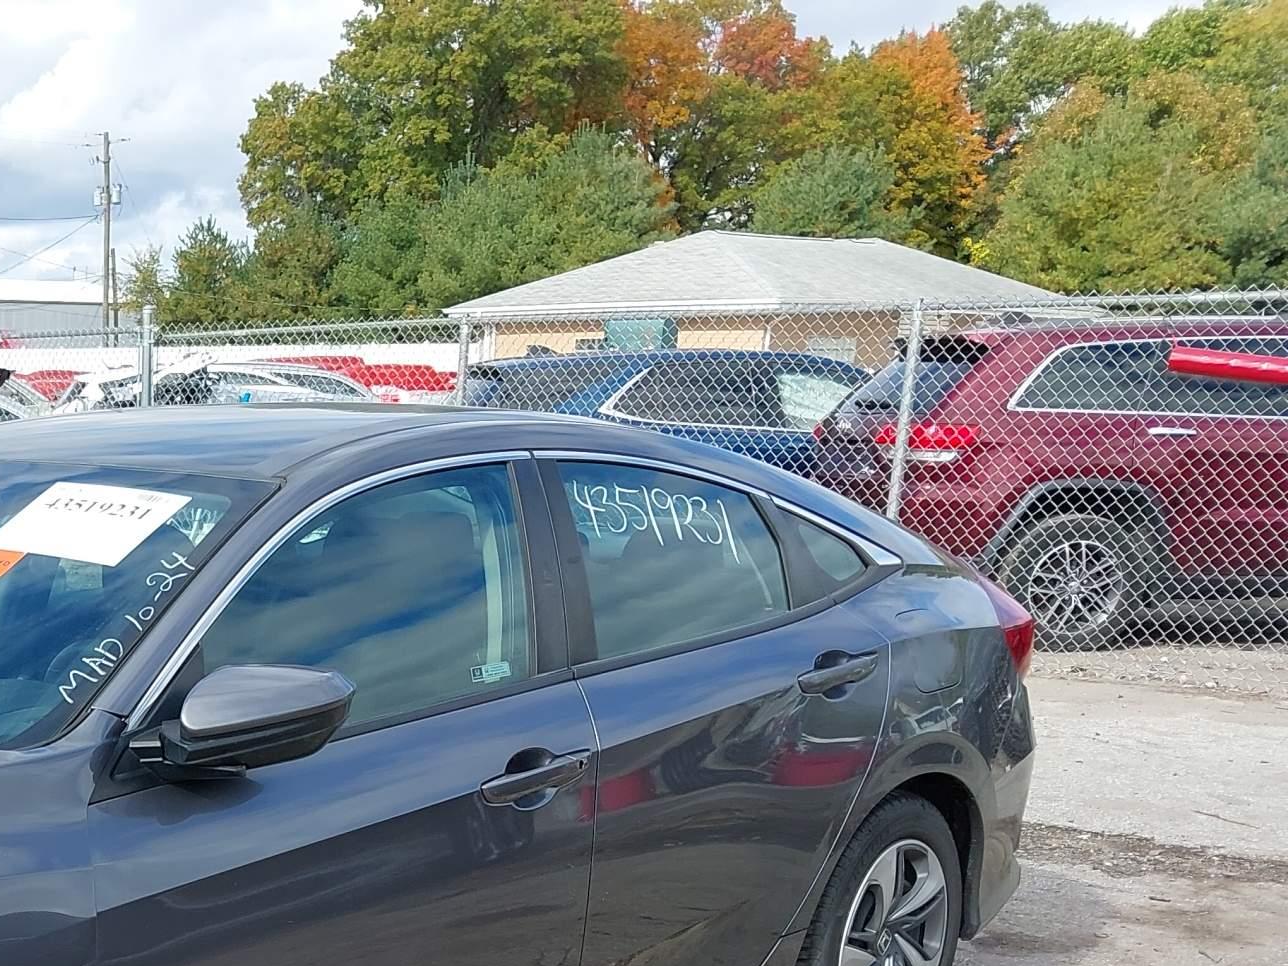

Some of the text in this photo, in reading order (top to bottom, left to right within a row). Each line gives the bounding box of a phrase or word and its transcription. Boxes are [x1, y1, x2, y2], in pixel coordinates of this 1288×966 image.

[45, 497, 152, 520] 43519231
[59, 638, 123, 704] MAD
[125, 551, 195, 632] 10-24
